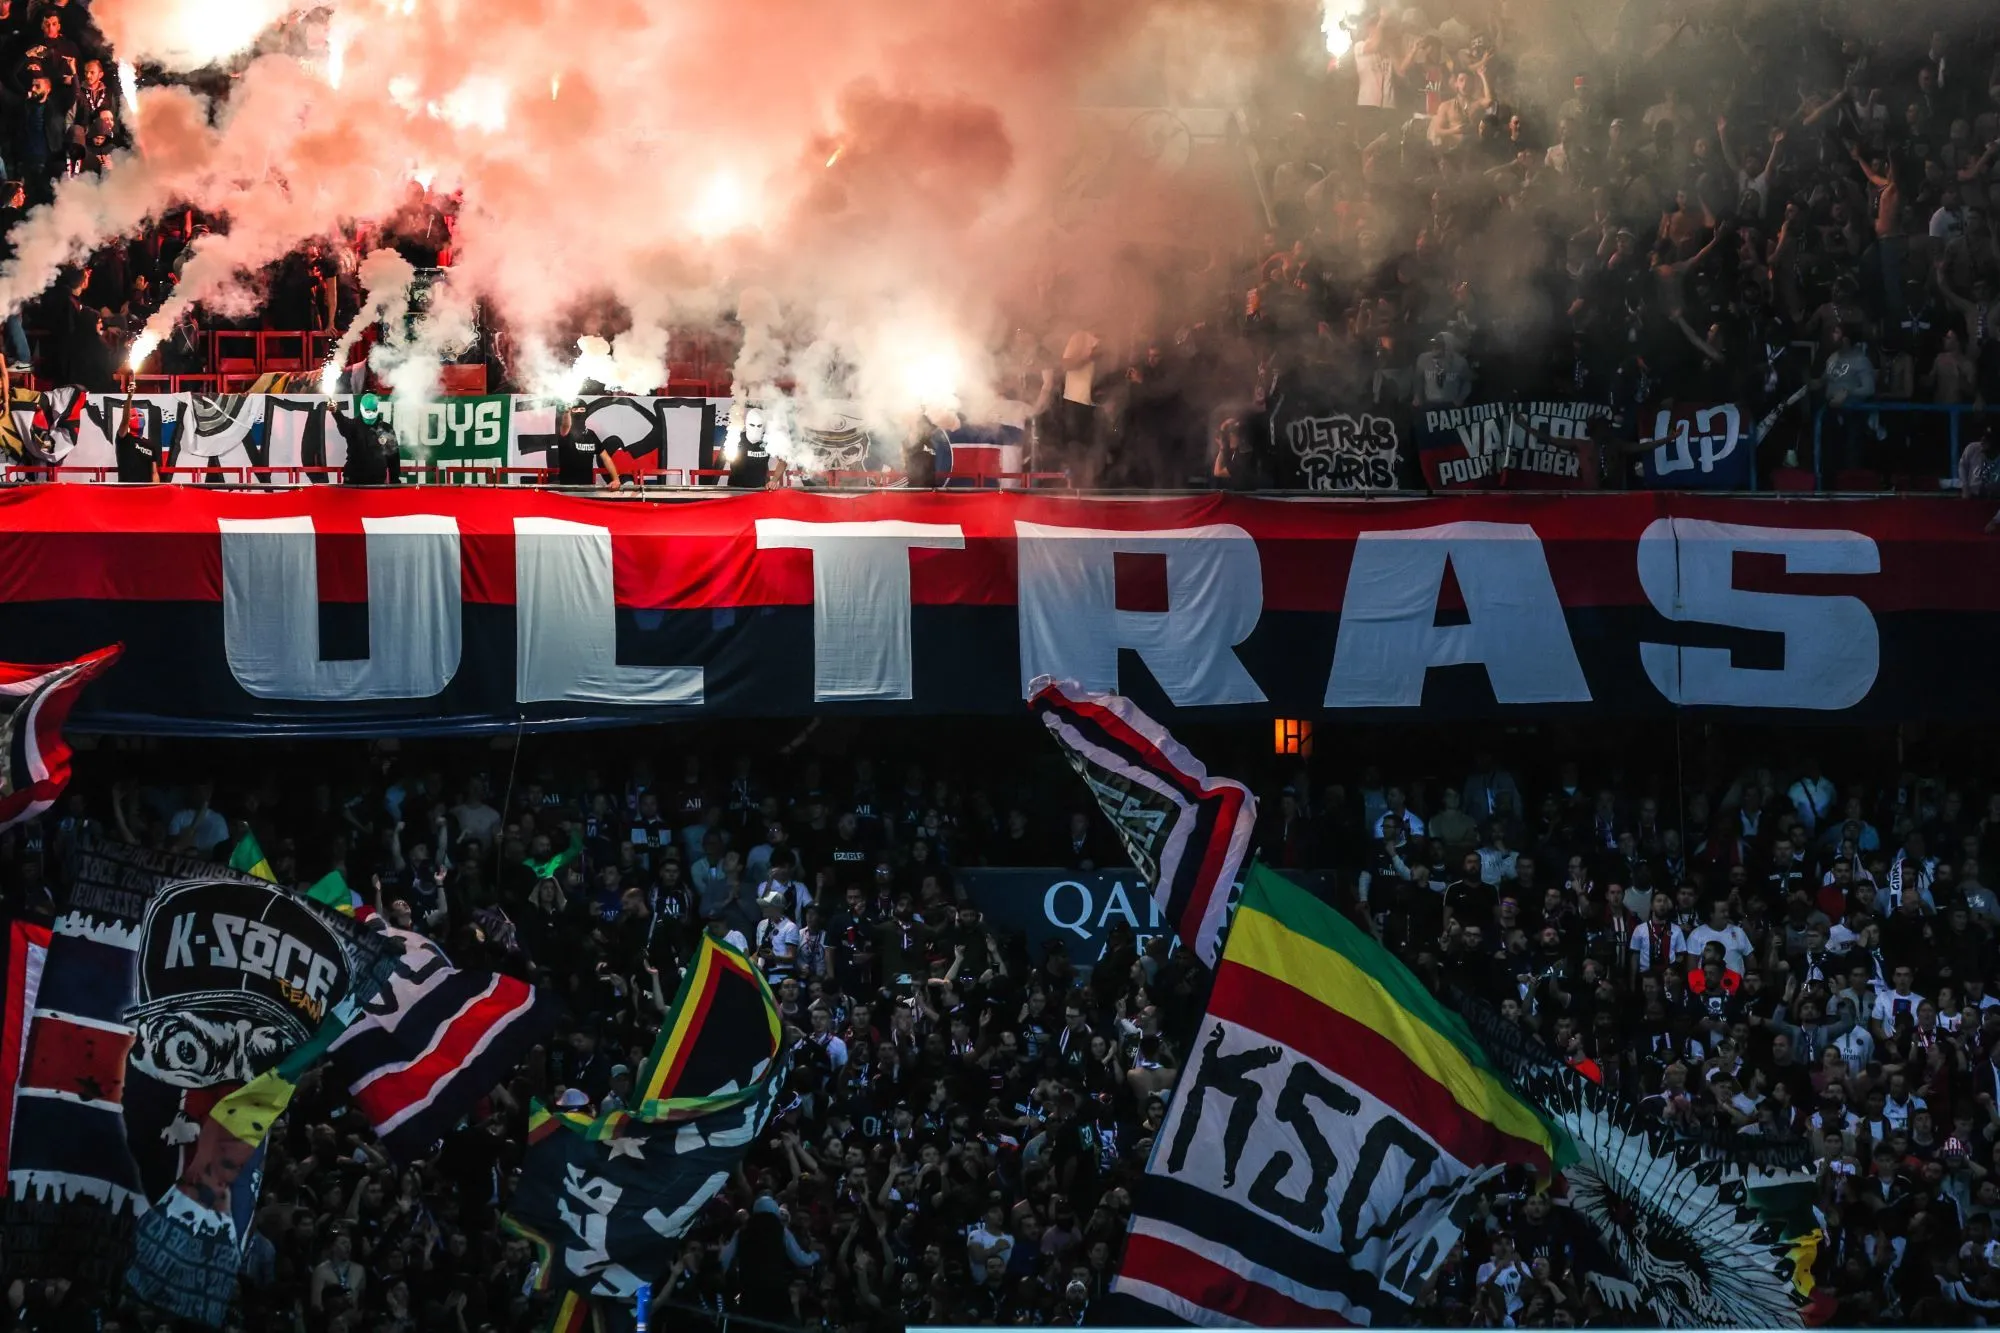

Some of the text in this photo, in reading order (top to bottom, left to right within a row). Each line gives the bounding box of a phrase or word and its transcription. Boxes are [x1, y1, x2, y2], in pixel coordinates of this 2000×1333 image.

[1286, 413, 1399, 456] ULTRAS
[1300, 451, 1398, 490] PARIS
[218, 514, 1881, 710] ULTRAS
